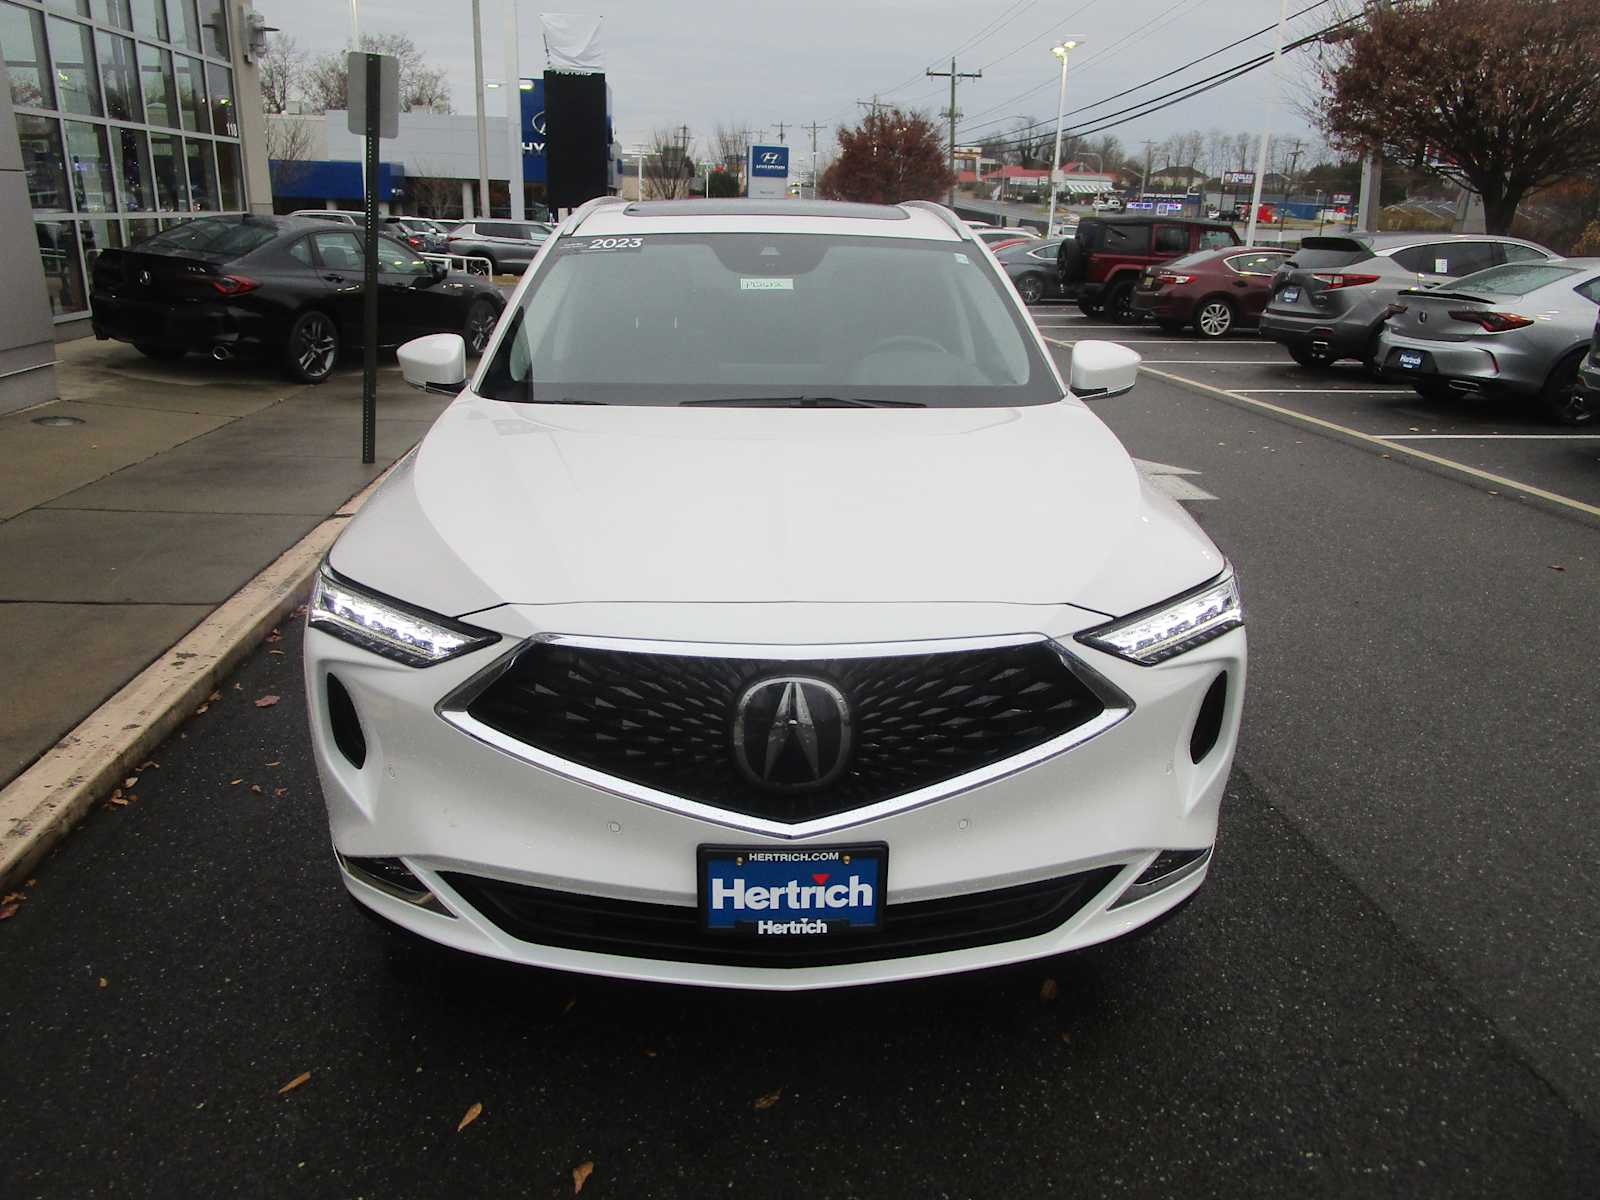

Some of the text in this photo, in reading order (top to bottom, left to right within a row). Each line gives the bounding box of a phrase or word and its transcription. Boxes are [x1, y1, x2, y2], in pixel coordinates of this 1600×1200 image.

[588, 237, 644, 250] 2023
[748, 851, 840, 863] HERTRICH.COM
[711, 873, 874, 911] Hertrich
[757, 917, 828, 935] Hertrich
